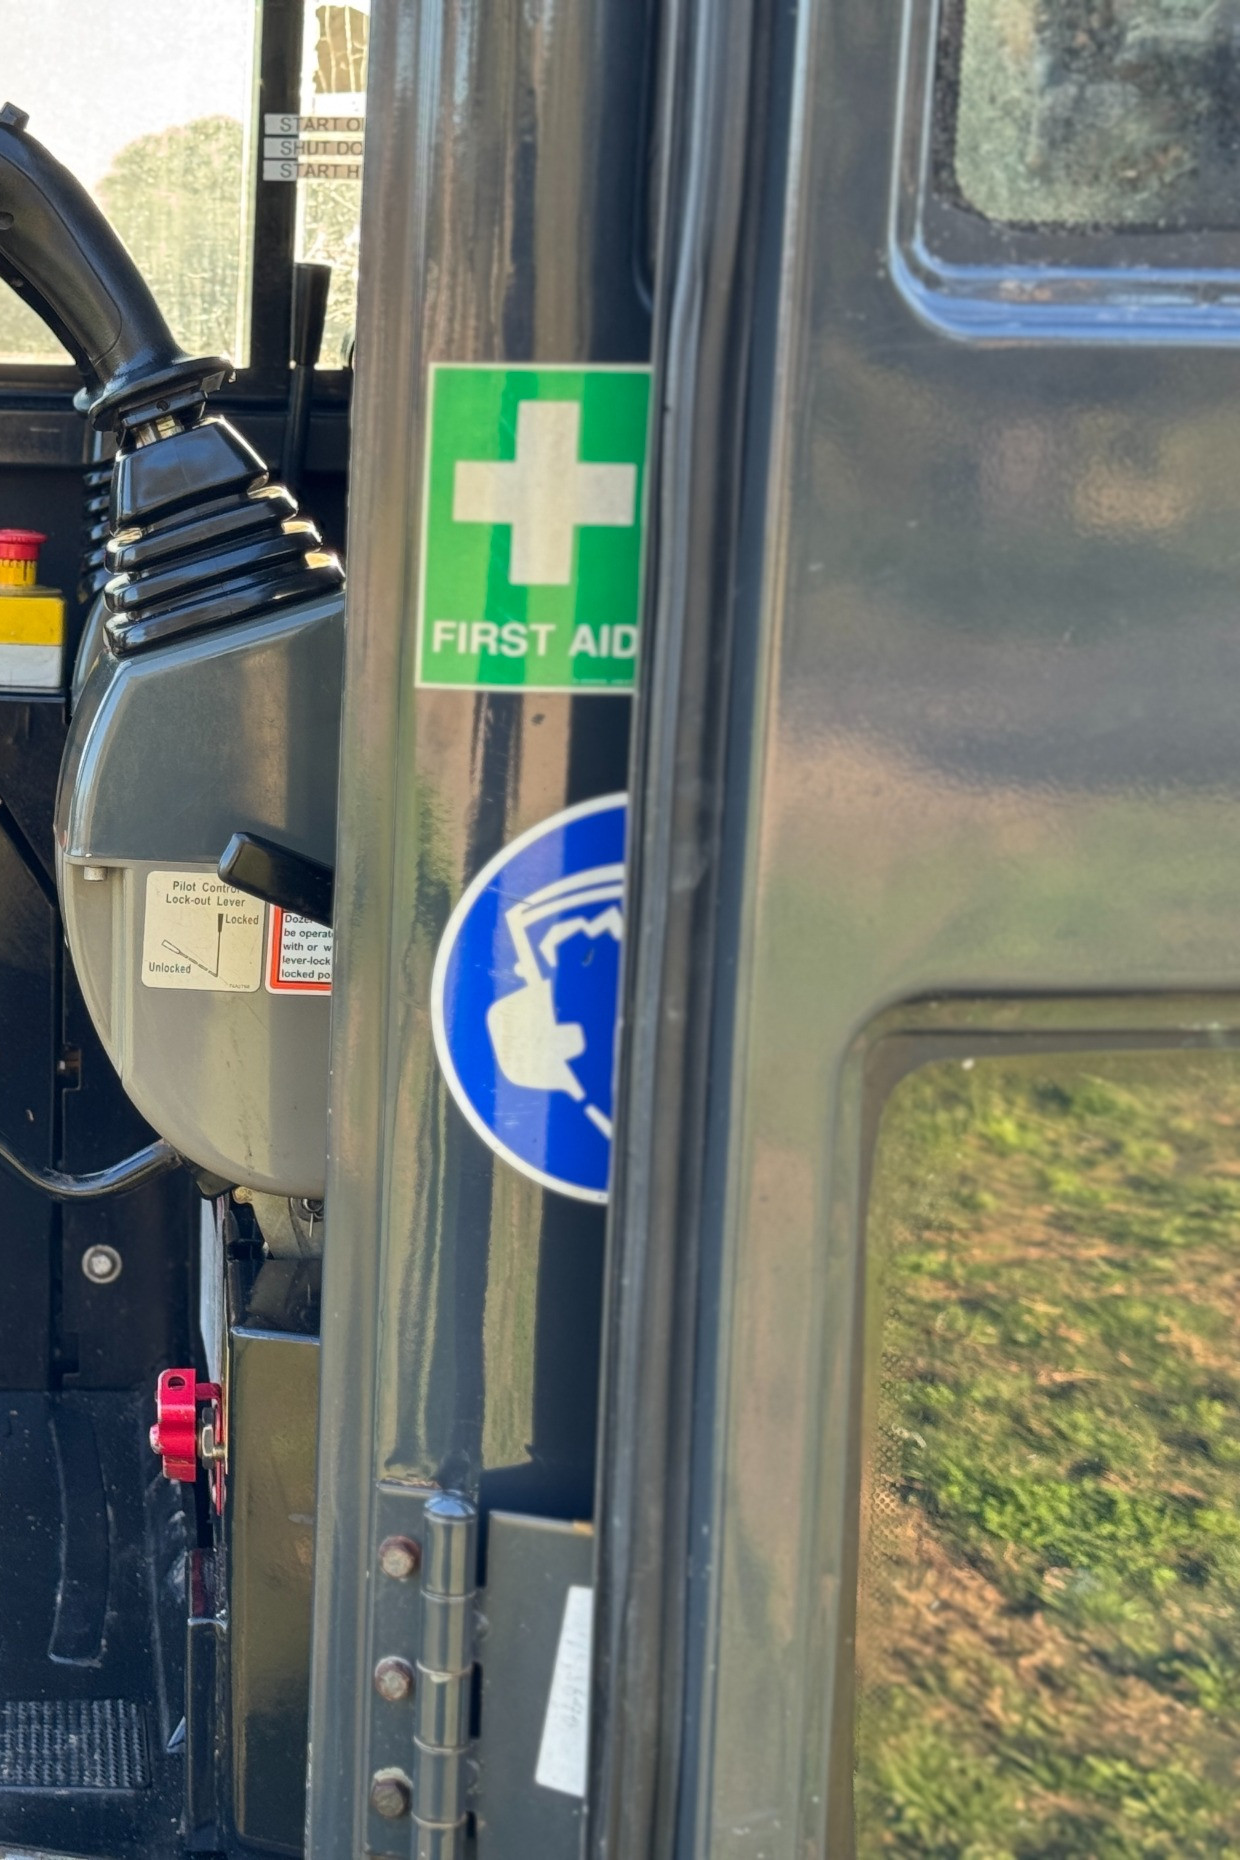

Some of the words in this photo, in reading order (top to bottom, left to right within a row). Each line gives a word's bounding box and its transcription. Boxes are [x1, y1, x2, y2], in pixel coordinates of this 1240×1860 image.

[280, 117, 340, 132] START
[346, 118, 364, 132] O
[280, 140, 330, 156] SHUT
[280, 163, 340, 178] START
[432, 620, 556, 658] FIRST
[568, 623, 638, 658] AID
[172, 881, 196, 892] Pilot
[166, 894, 211, 906] Lock-out
[217, 896, 245, 907] Lever
[225, 914, 259, 925] Locked
[285, 914, 312, 923] Doze
[284, 928, 296, 937] be
[283, 942, 304, 951] with
[282, 955, 330, 965] lever-lock
[149, 962, 192, 974] Unlocked
[282, 969, 315, 978] locked
